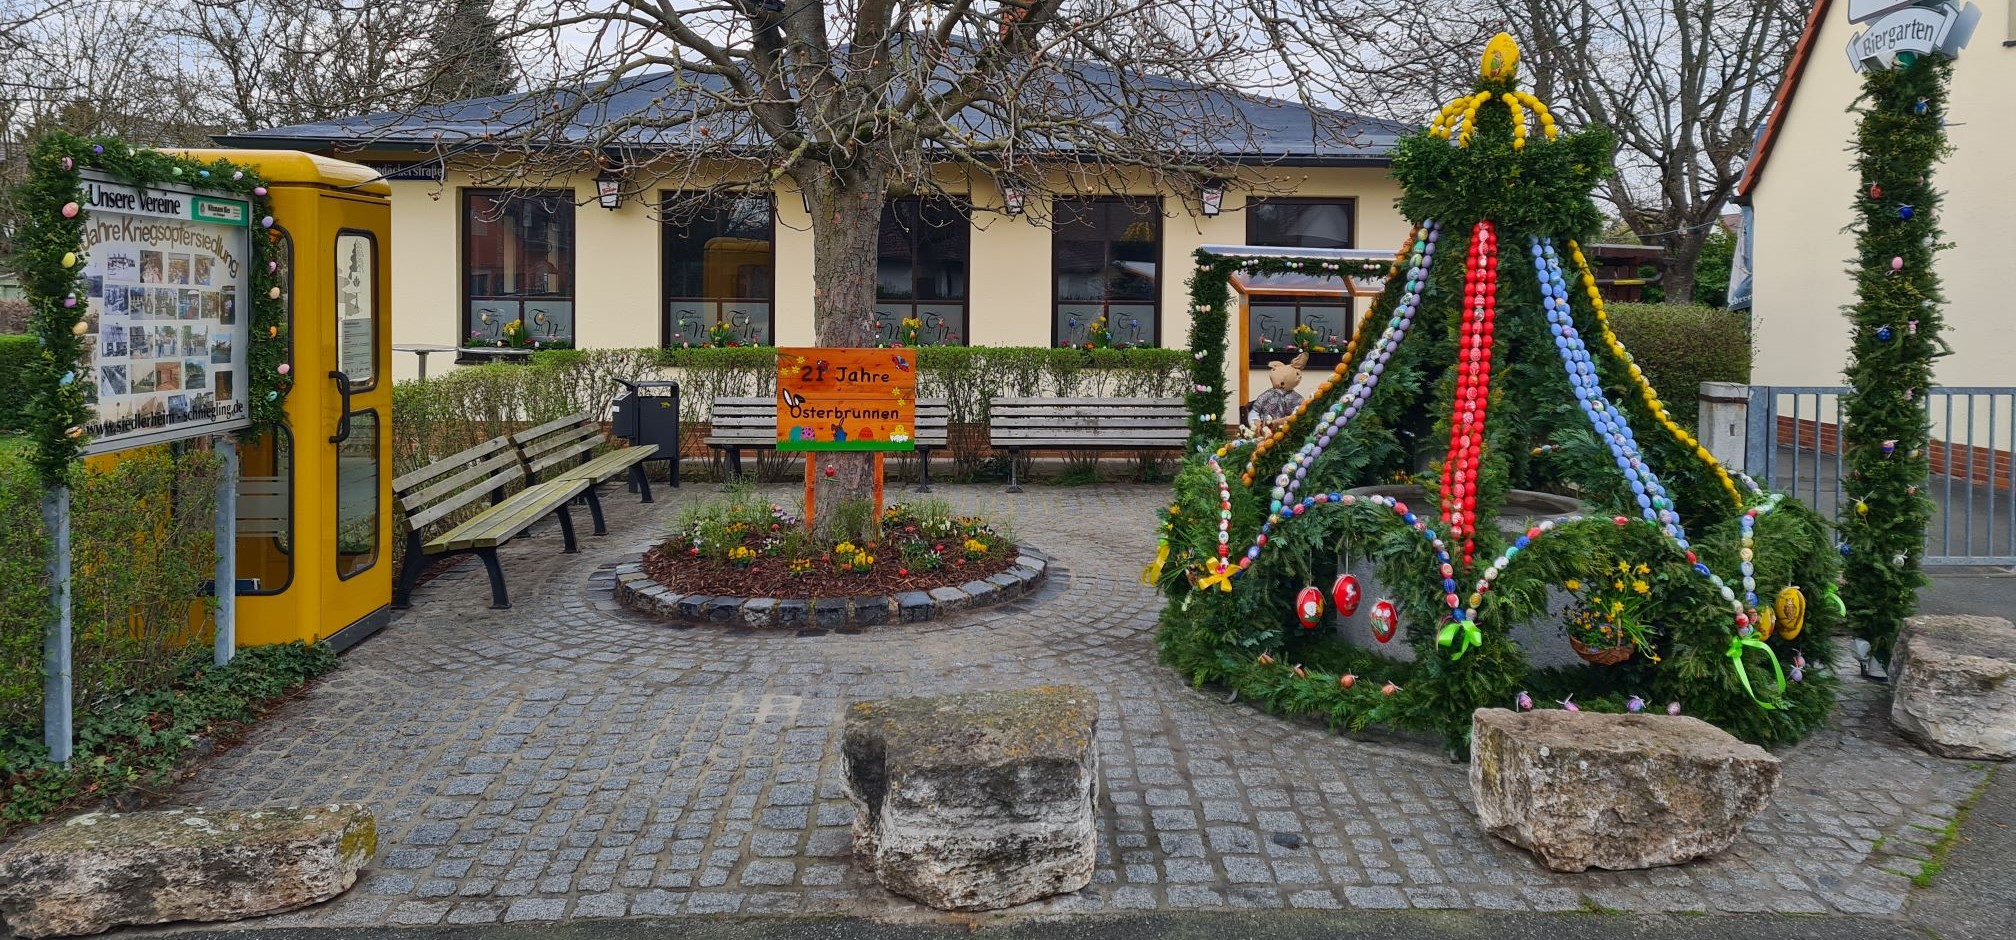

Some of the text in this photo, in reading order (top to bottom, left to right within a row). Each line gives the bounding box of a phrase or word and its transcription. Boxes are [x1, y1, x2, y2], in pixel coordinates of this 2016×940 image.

[1863, 18, 1934, 56] Biergarten
[89, 184, 181, 214] Unsere Vereine
[82, 216, 239, 278] Jahre Kriegsopfersiedlung
[802, 365, 890, 382] 21 Jahre
[790, 406, 899, 419] Osterbrunnen
